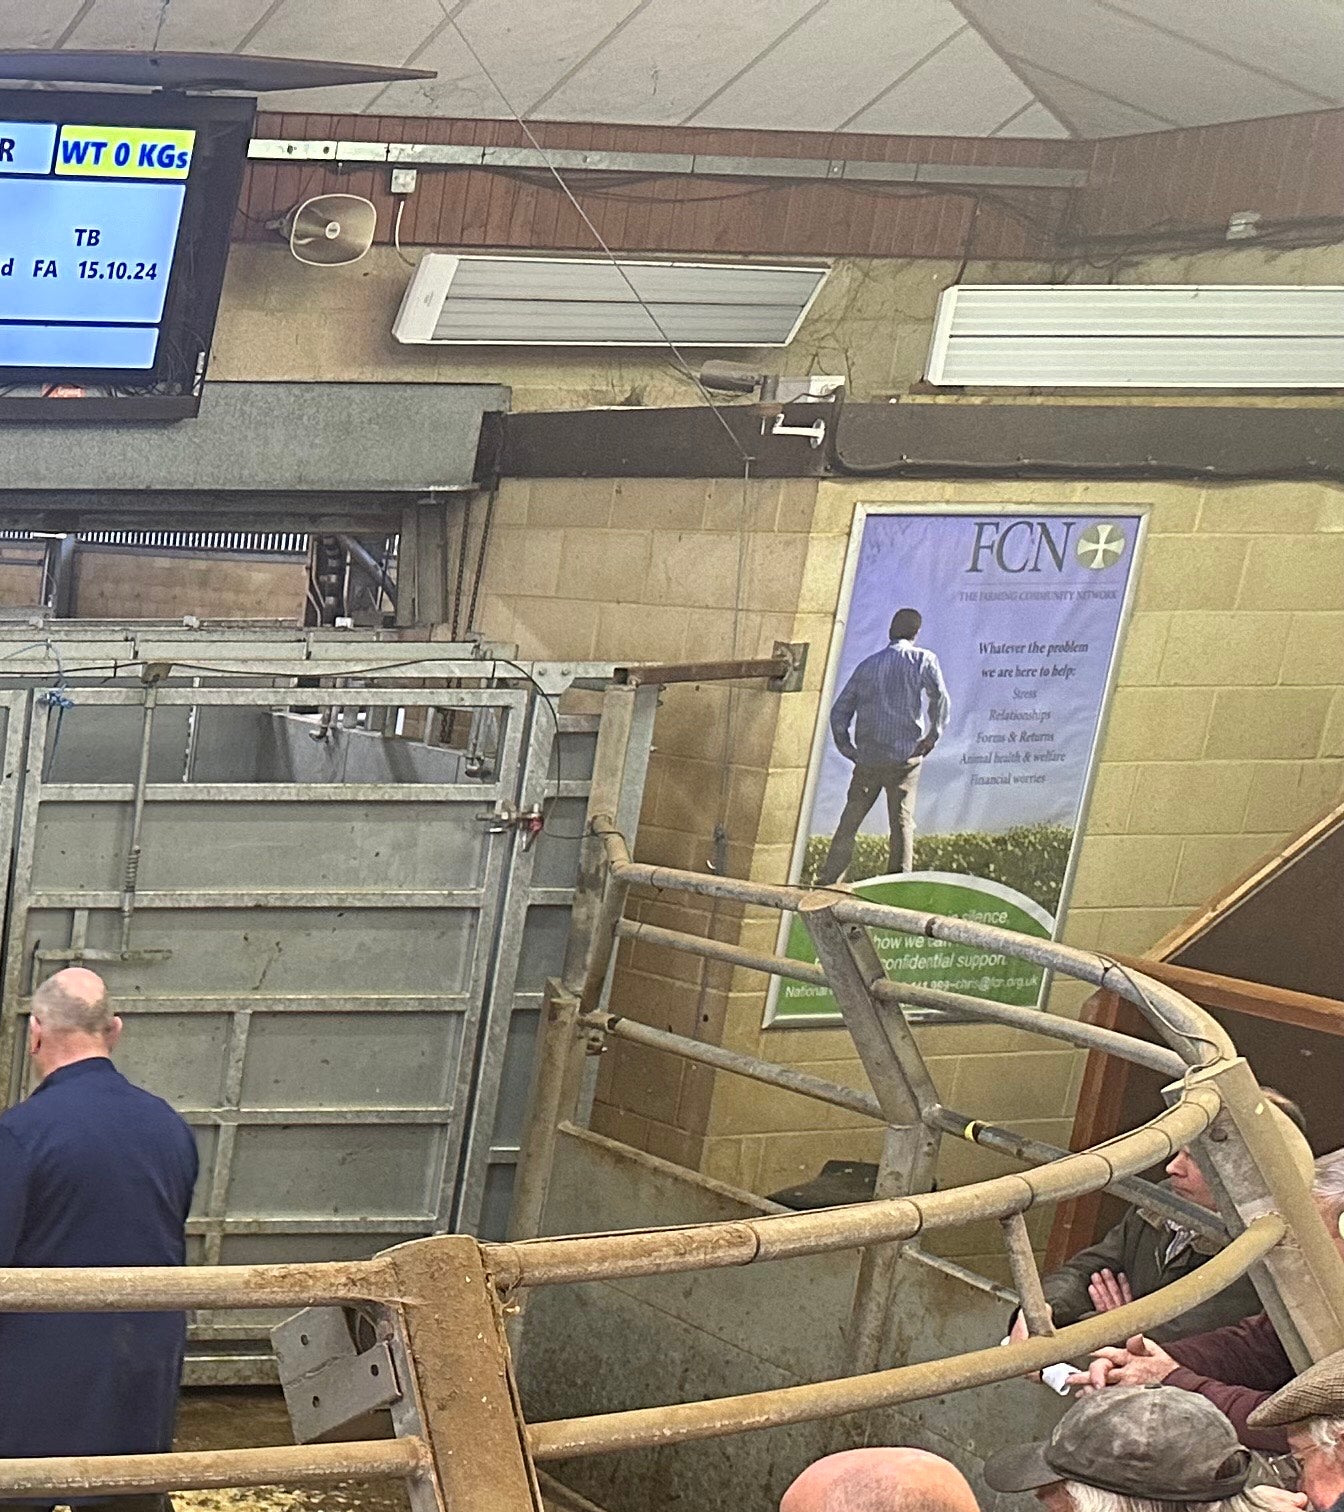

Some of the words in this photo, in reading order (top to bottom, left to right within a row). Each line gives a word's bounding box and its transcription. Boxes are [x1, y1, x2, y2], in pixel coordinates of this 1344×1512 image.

[62, 141, 107, 165] WT
[114, 143, 130, 166] 0
[138, 144, 188, 169] KGs
[75, 229, 101, 246] TB
[33, 260, 58, 277] FA
[78, 261, 157, 280] 15.10.24
[965, 520, 1077, 573] FCN
[979, 641, 1025, 655] Whatever
[1028, 641, 1046, 654] the
[1048, 640, 1089, 657] problem
[981, 669, 994, 678] we
[997, 669, 1013, 678] are
[1015, 665, 1037, 678] here
[1040, 666, 1050, 677] to
[1052, 664, 1076, 680] help:
[1012, 688, 1038, 699] Stress
[989, 709, 1052, 723] Relationships
[976, 732, 1005, 743] Forms
[1007, 731, 1016, 743] &
[1019, 731, 1054, 743] Returns
[960, 752, 993, 764] Animal
[993, 751, 1021, 763] health
[1022, 752, 1030, 763] &
[1033, 750, 1066, 762] welfare
[970, 773, 1011, 786] Financial
[1013, 775, 1046, 785] worries
[873, 935, 902, 950] how
[904, 936, 925, 948] we
